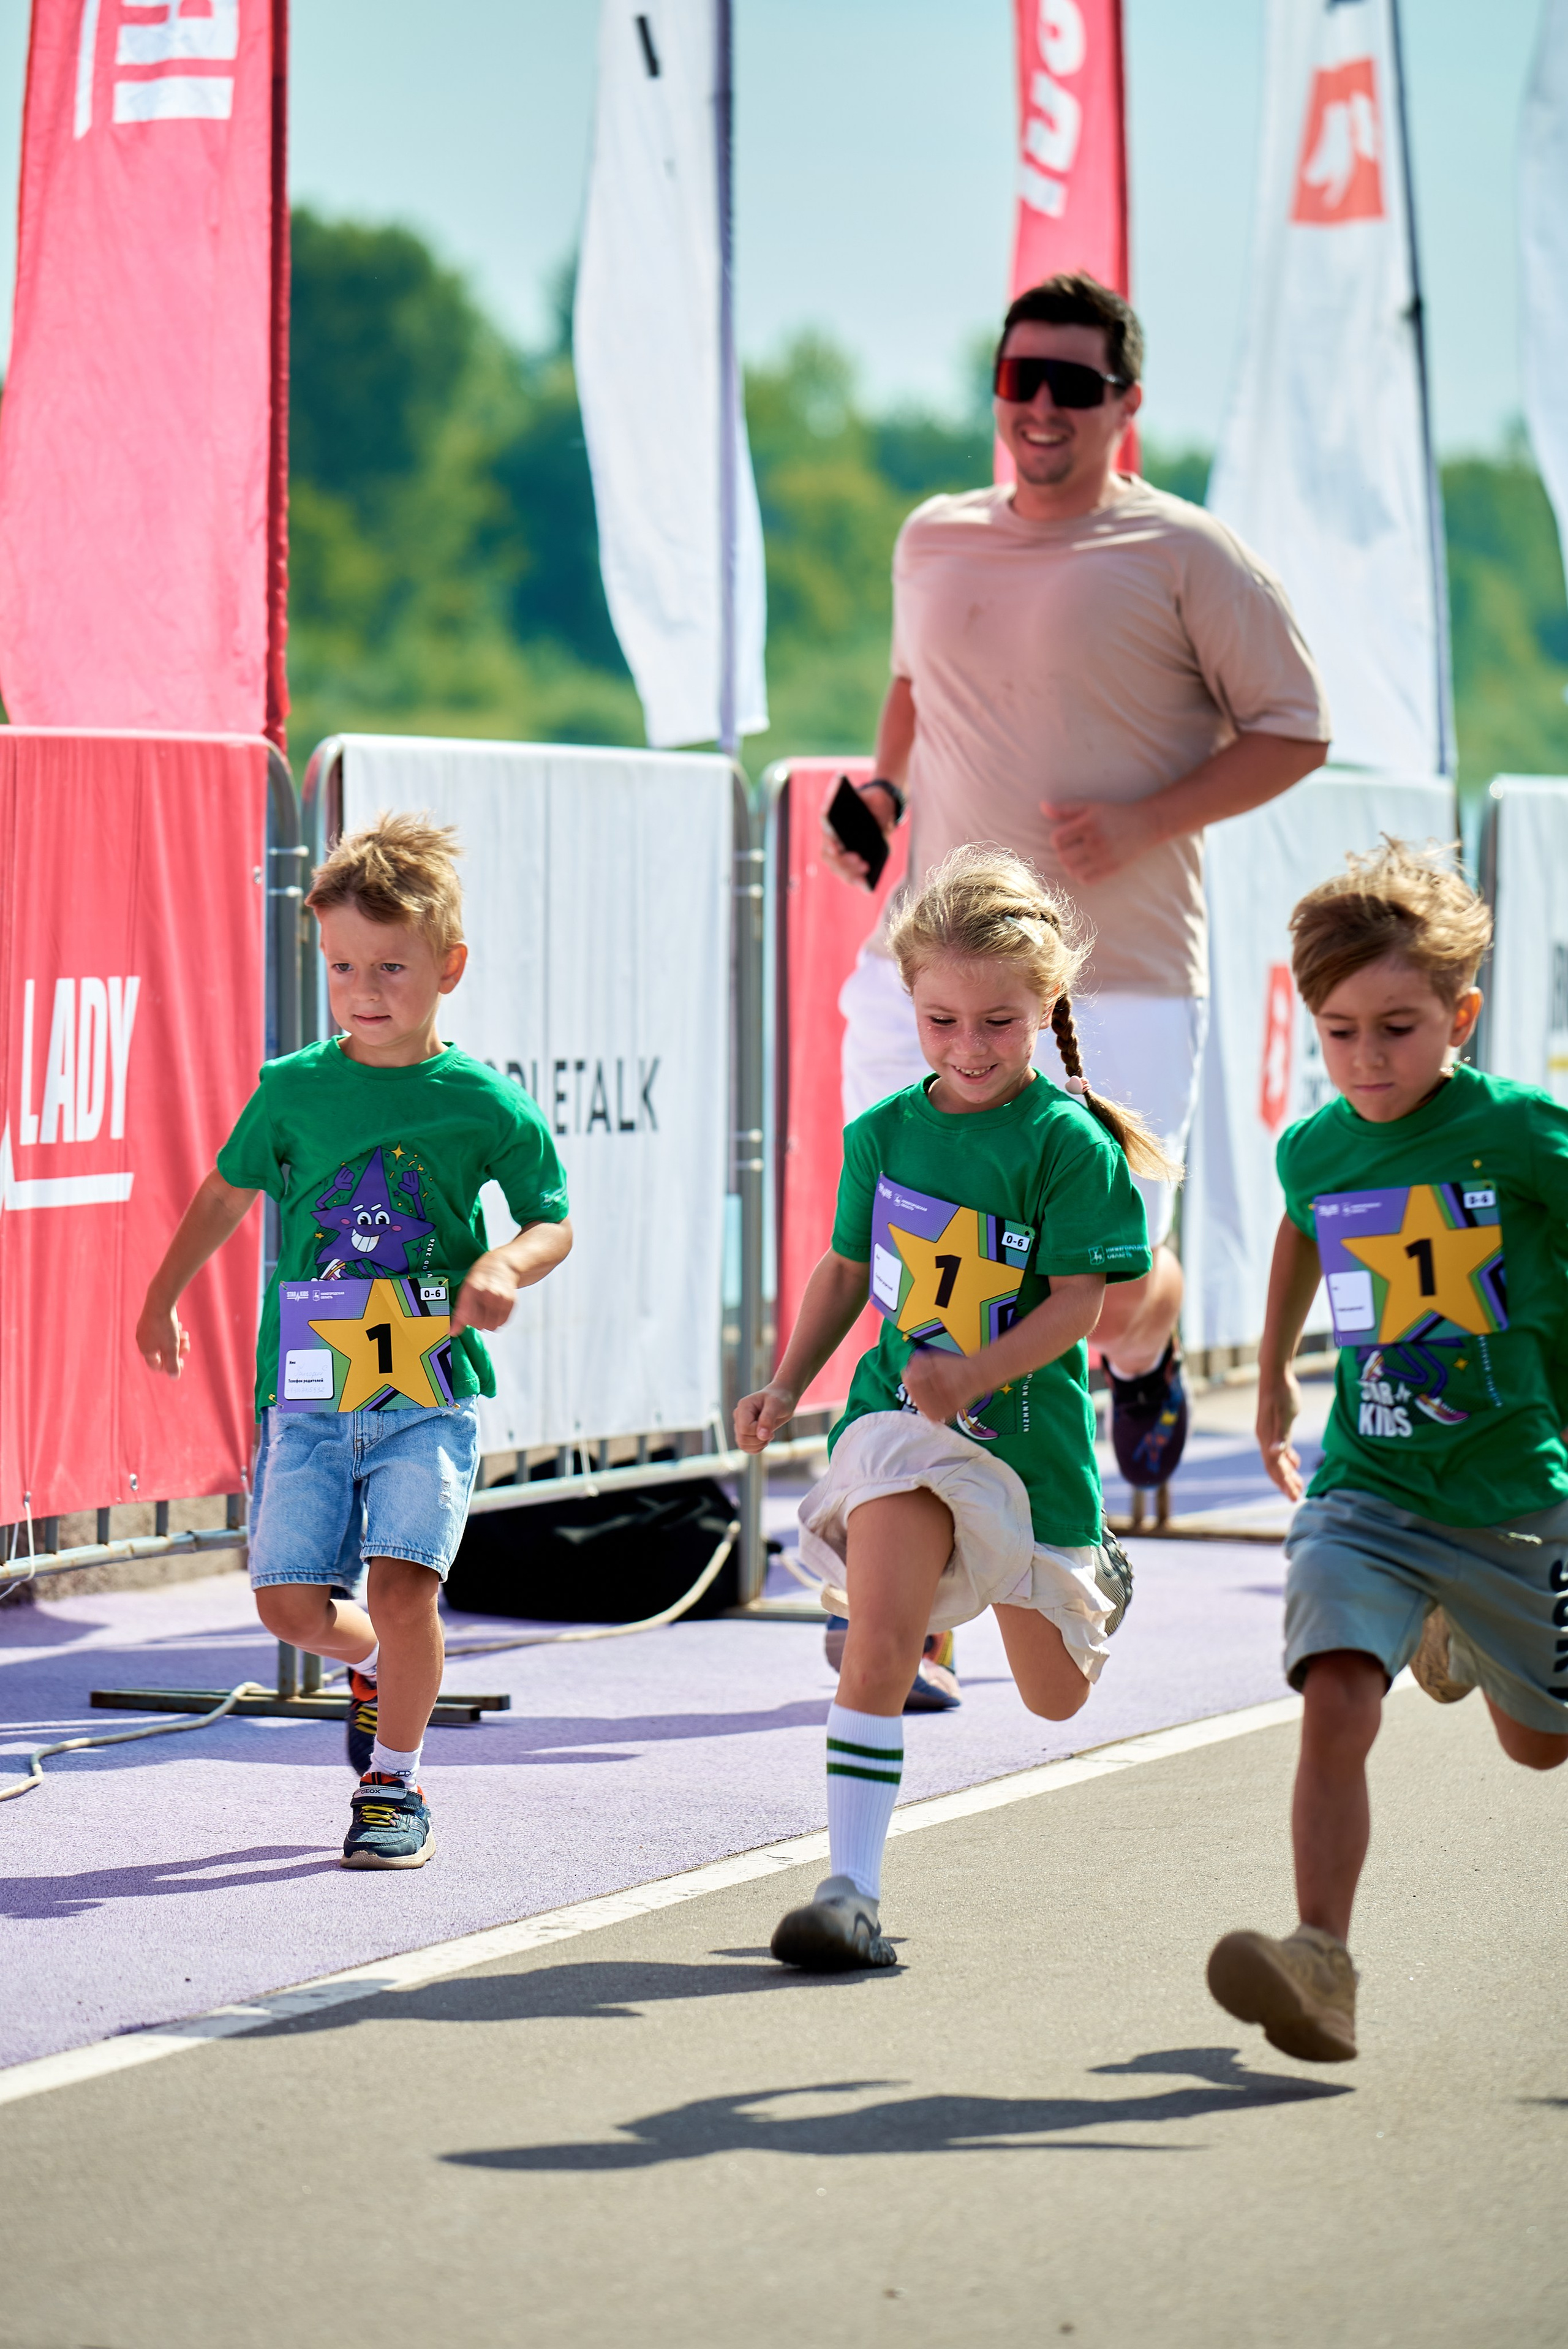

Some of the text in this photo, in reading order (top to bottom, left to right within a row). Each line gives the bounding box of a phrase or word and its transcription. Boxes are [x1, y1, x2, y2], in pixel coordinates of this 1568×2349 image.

[20, 976, 141, 1145] LADY
[426, 1239, 435, 1257] 2024
[1006, 1235, 1024, 1247] 0-6
[935, 1254, 962, 1309] 1
[1404, 1238, 1436, 1297] 1
[424, 1289, 441, 1298] 0-6
[365, 1323, 393, 1374] 1
[1359, 1401, 1413, 1438] KIDS
